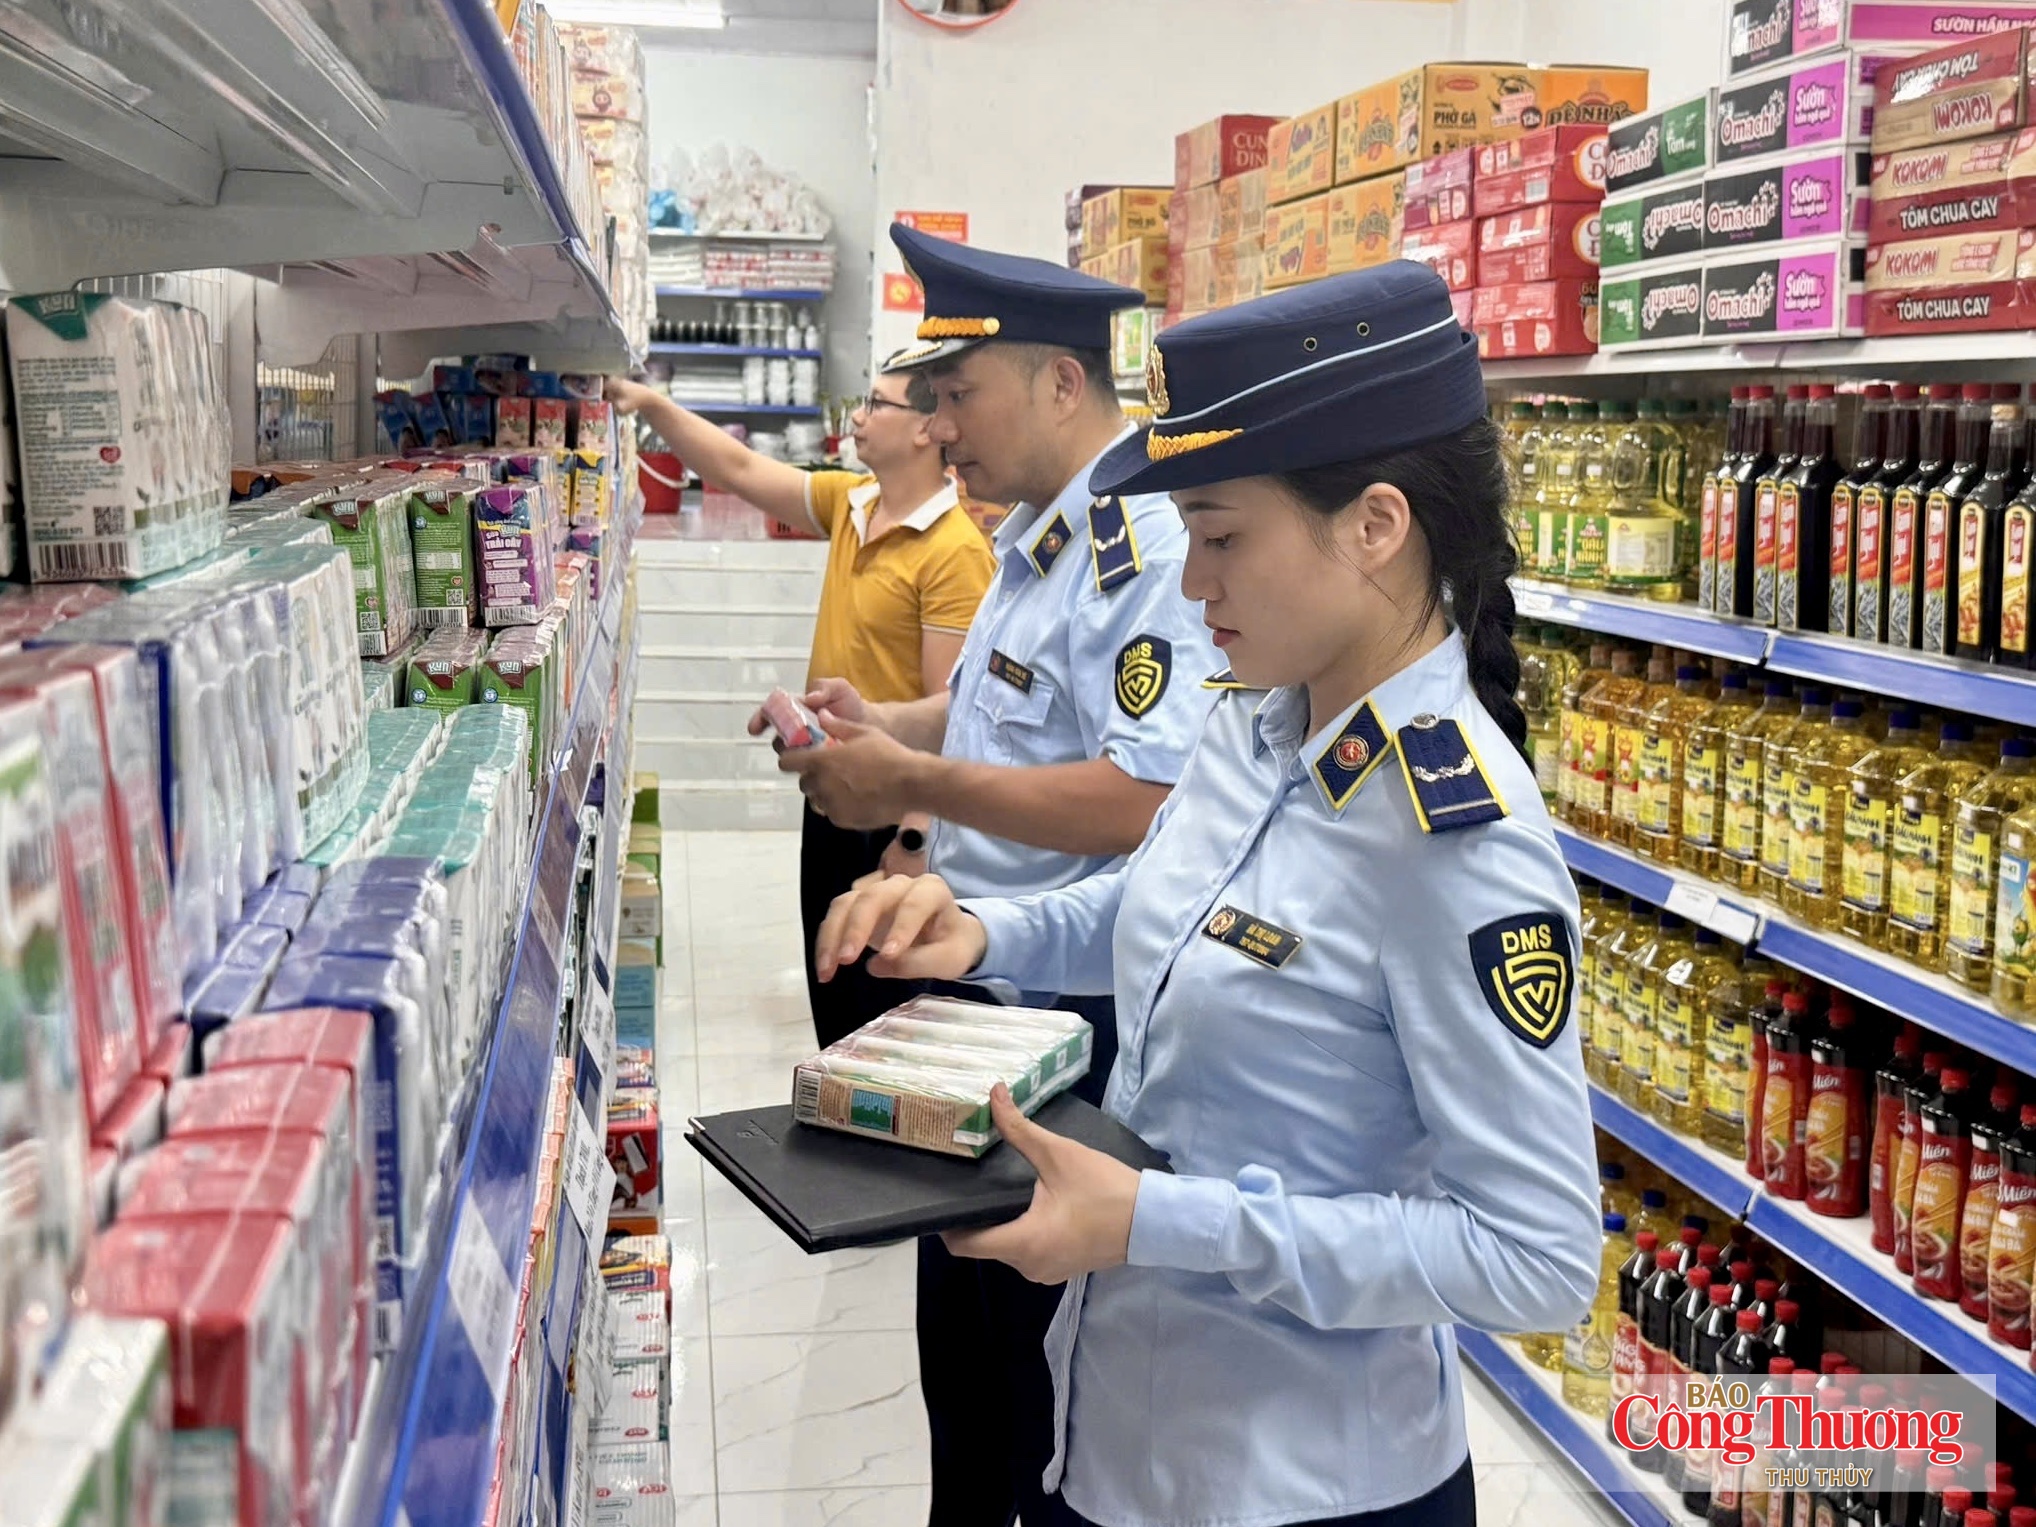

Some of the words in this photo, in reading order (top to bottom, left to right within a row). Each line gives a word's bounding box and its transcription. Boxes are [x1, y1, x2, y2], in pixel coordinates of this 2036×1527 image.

[1934, 15, 1975, 32] SƯỜN
[1720, 105, 1776, 146] Omachi
[1933, 92, 1994, 133] KOKOMI
[1892, 152, 1948, 187] KOKOMI
[1790, 178, 1821, 204] Sườn
[1707, 196, 1769, 233] Omachi
[1900, 206, 1929, 230] TÔM
[1930, 202, 1969, 226] CHUA
[1970, 197, 1999, 219] CAY
[1885, 248, 1939, 278] KOKOMI
[1786, 270, 1816, 297] Sườn
[1706, 286, 1764, 321] Omachi
[1896, 297, 1923, 321] TÔM
[1924, 299, 1961, 319] CHUA
[1962, 296, 1990, 317] CAY
[1501, 923, 1553, 954] DMS
